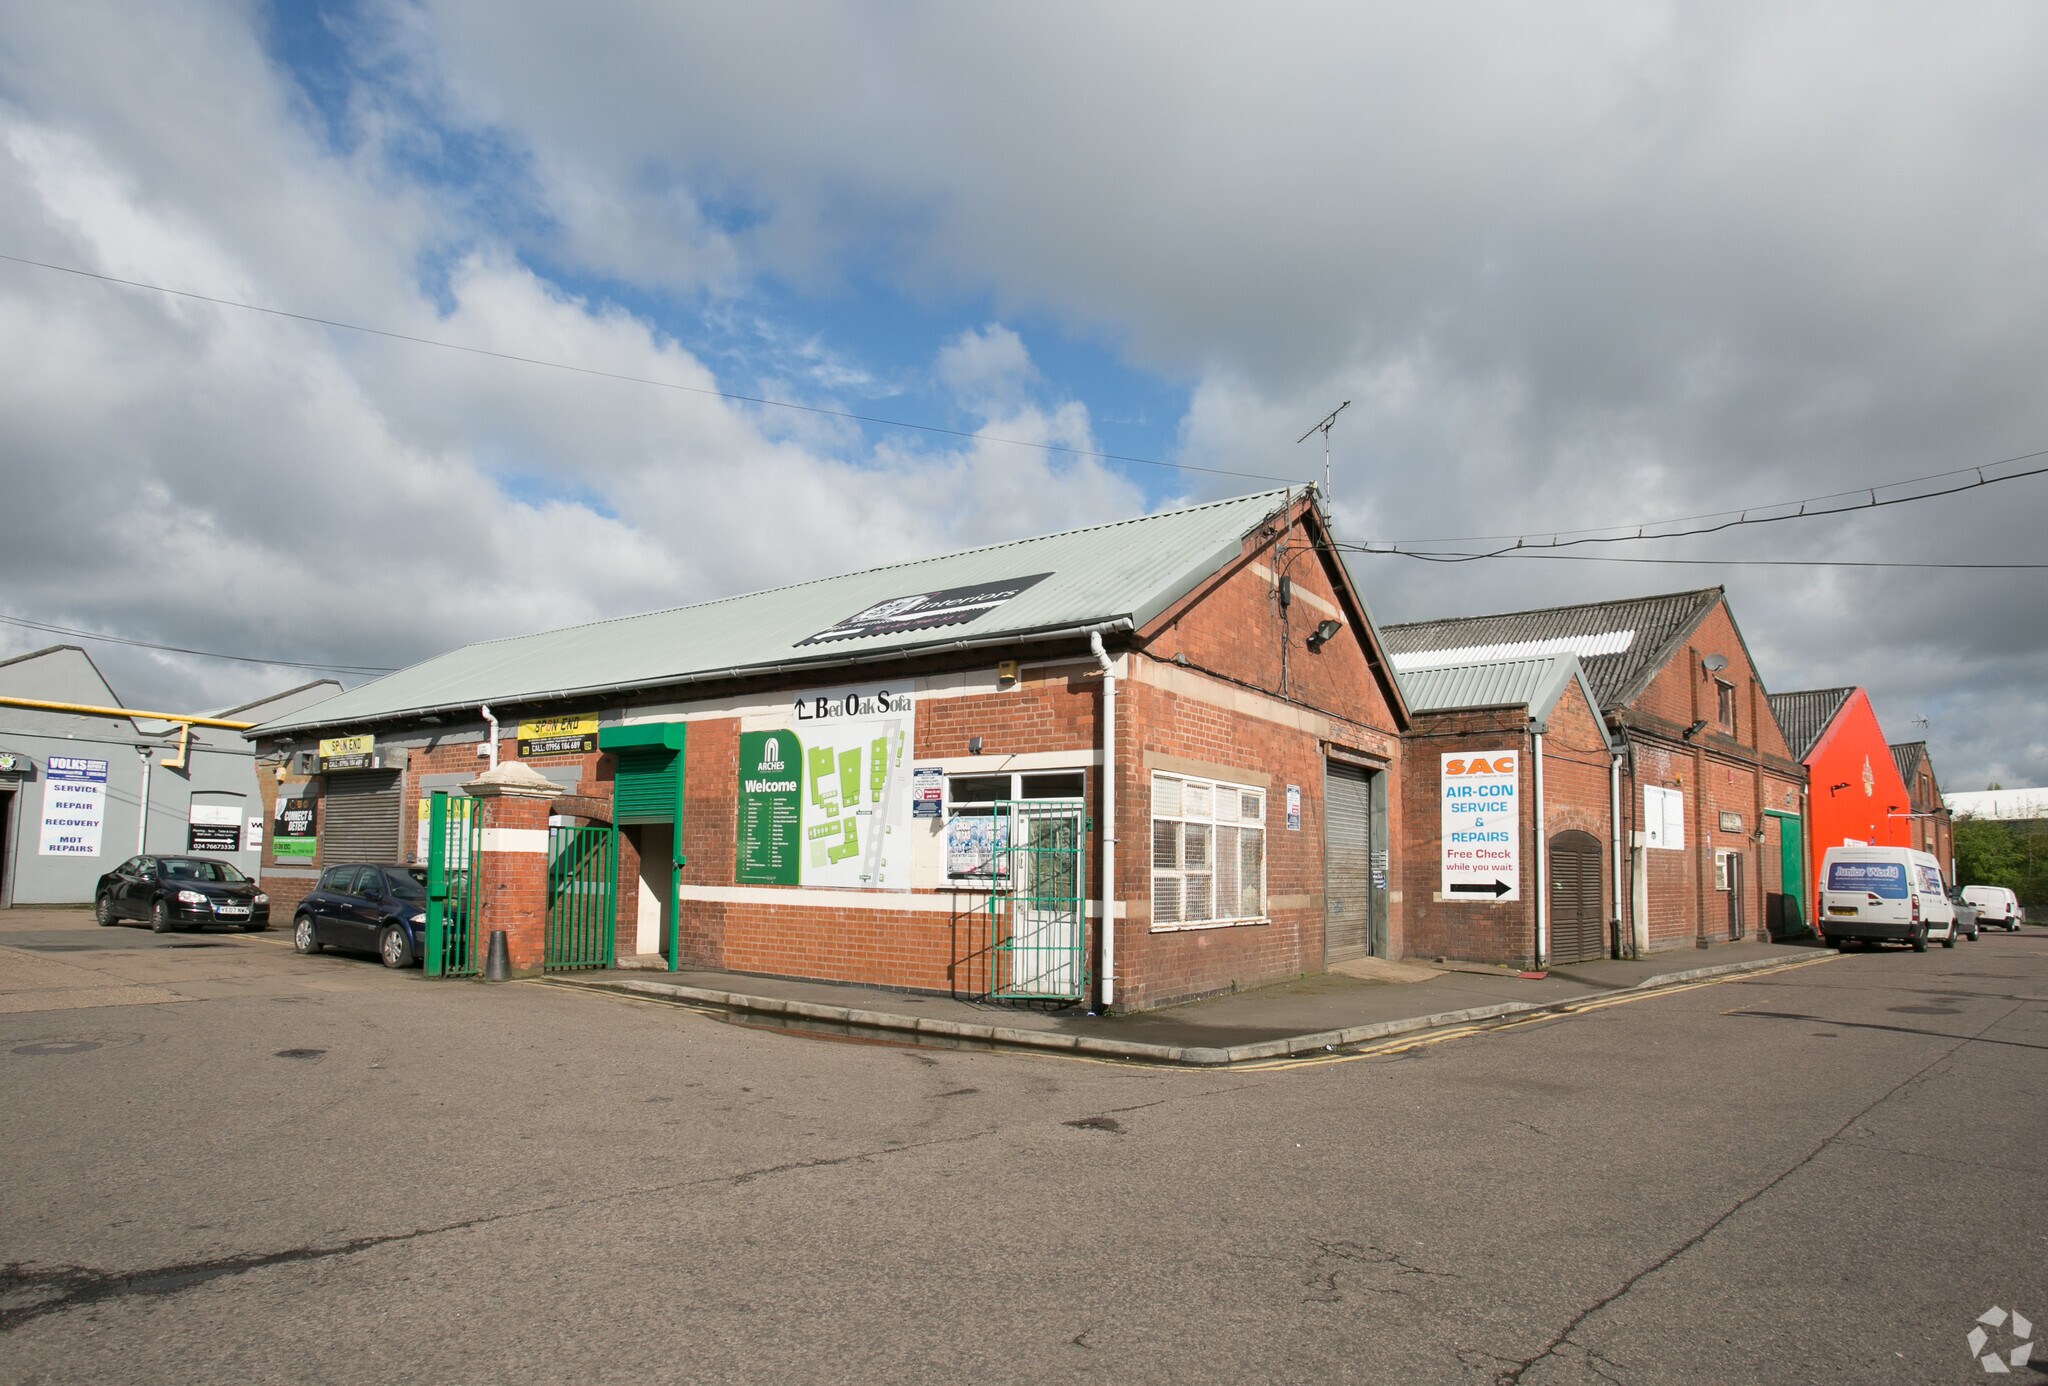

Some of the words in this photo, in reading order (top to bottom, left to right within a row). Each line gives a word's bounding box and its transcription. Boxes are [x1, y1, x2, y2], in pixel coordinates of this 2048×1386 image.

[914, 589, 1019, 611] interiors
[815, 697, 844, 719] Bed
[845, 693, 875, 716] Oak
[877, 690, 912, 713] Sofa
[535, 719, 559, 733] SPON
[560, 716, 580, 731] END
[349, 738, 362, 750] END
[50, 757, 88, 770] VOLKS
[758, 761, 784, 771] ARCHES
[1445, 756, 1514, 775] SAC
[54, 784, 98, 794] SERVICE
[744, 778, 797, 793] Welcome
[1446, 785, 1514, 798] AIR-CON
[56, 802, 93, 810] REPAIR
[1451, 802, 1508, 813] SERVICE
[284, 810, 308, 821] CONNECT
[45, 818, 100, 827] RECOVERY
[287, 821, 308, 831] DETECT
[1475, 817, 1484, 827] &
[1451, 832, 1509, 842] REPAIRS
[1447, 849, 1473, 858] Free
[1475, 849, 1511, 858] Check
[1472, 864, 1489, 872] you
[1835, 866, 1866, 877] Junior
[1867, 866, 1899, 878] World
